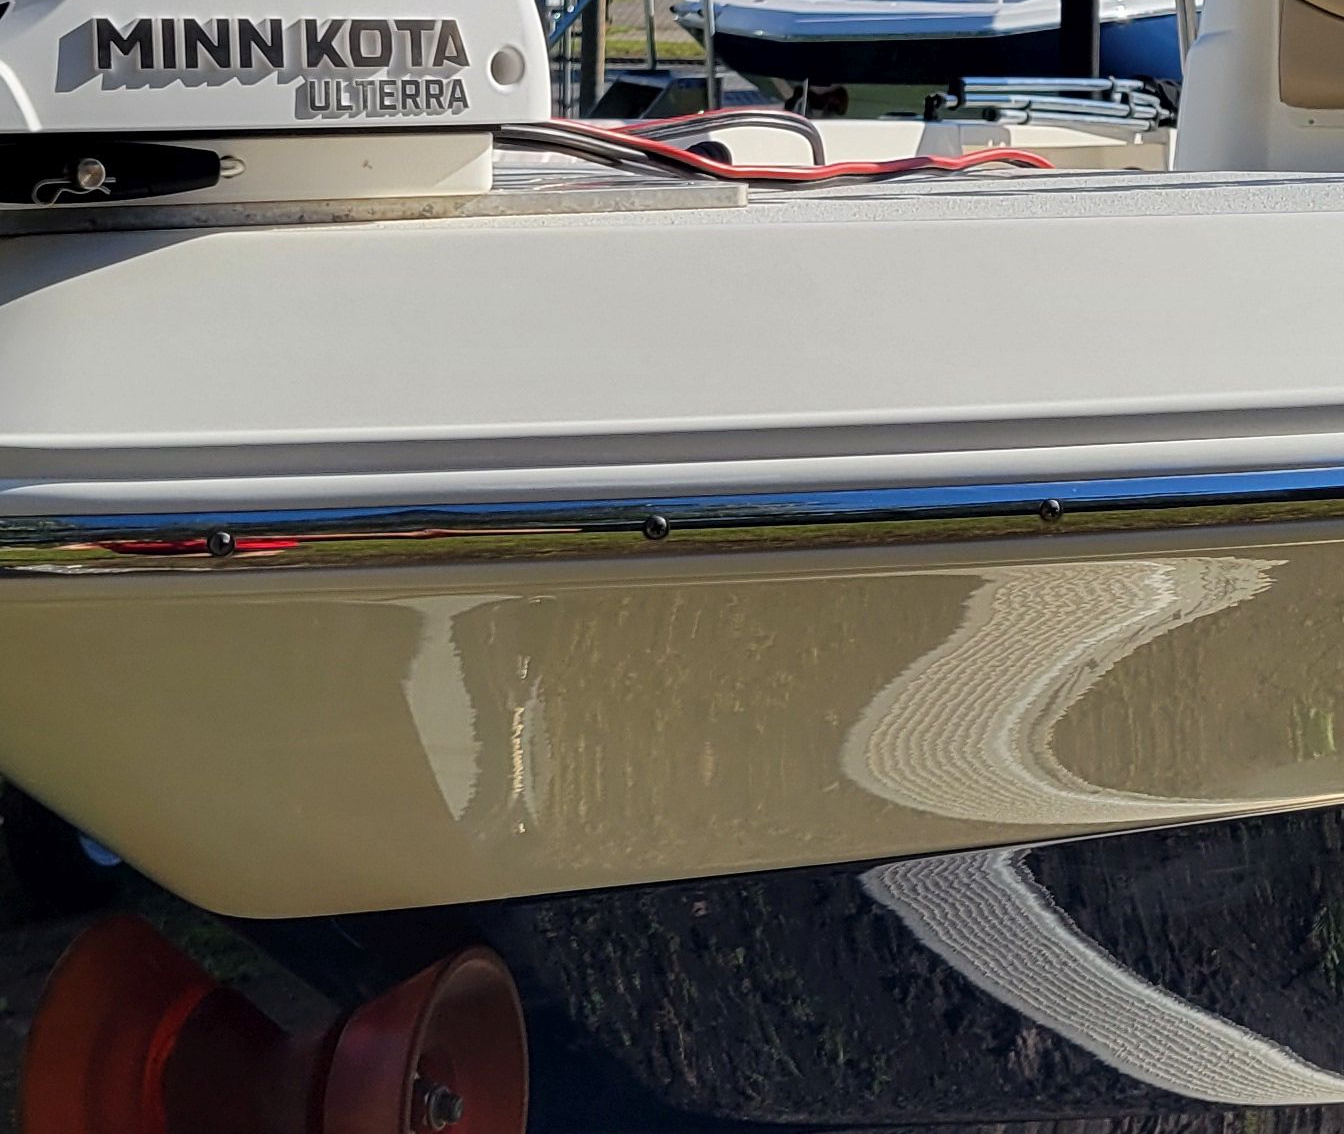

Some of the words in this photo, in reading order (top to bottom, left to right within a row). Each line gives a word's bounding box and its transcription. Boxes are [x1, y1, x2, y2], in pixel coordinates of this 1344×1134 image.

[94, 17, 285, 70] MINN
[304, 18, 471, 69] KOTA
[308, 78, 471, 113] ULTERRA
